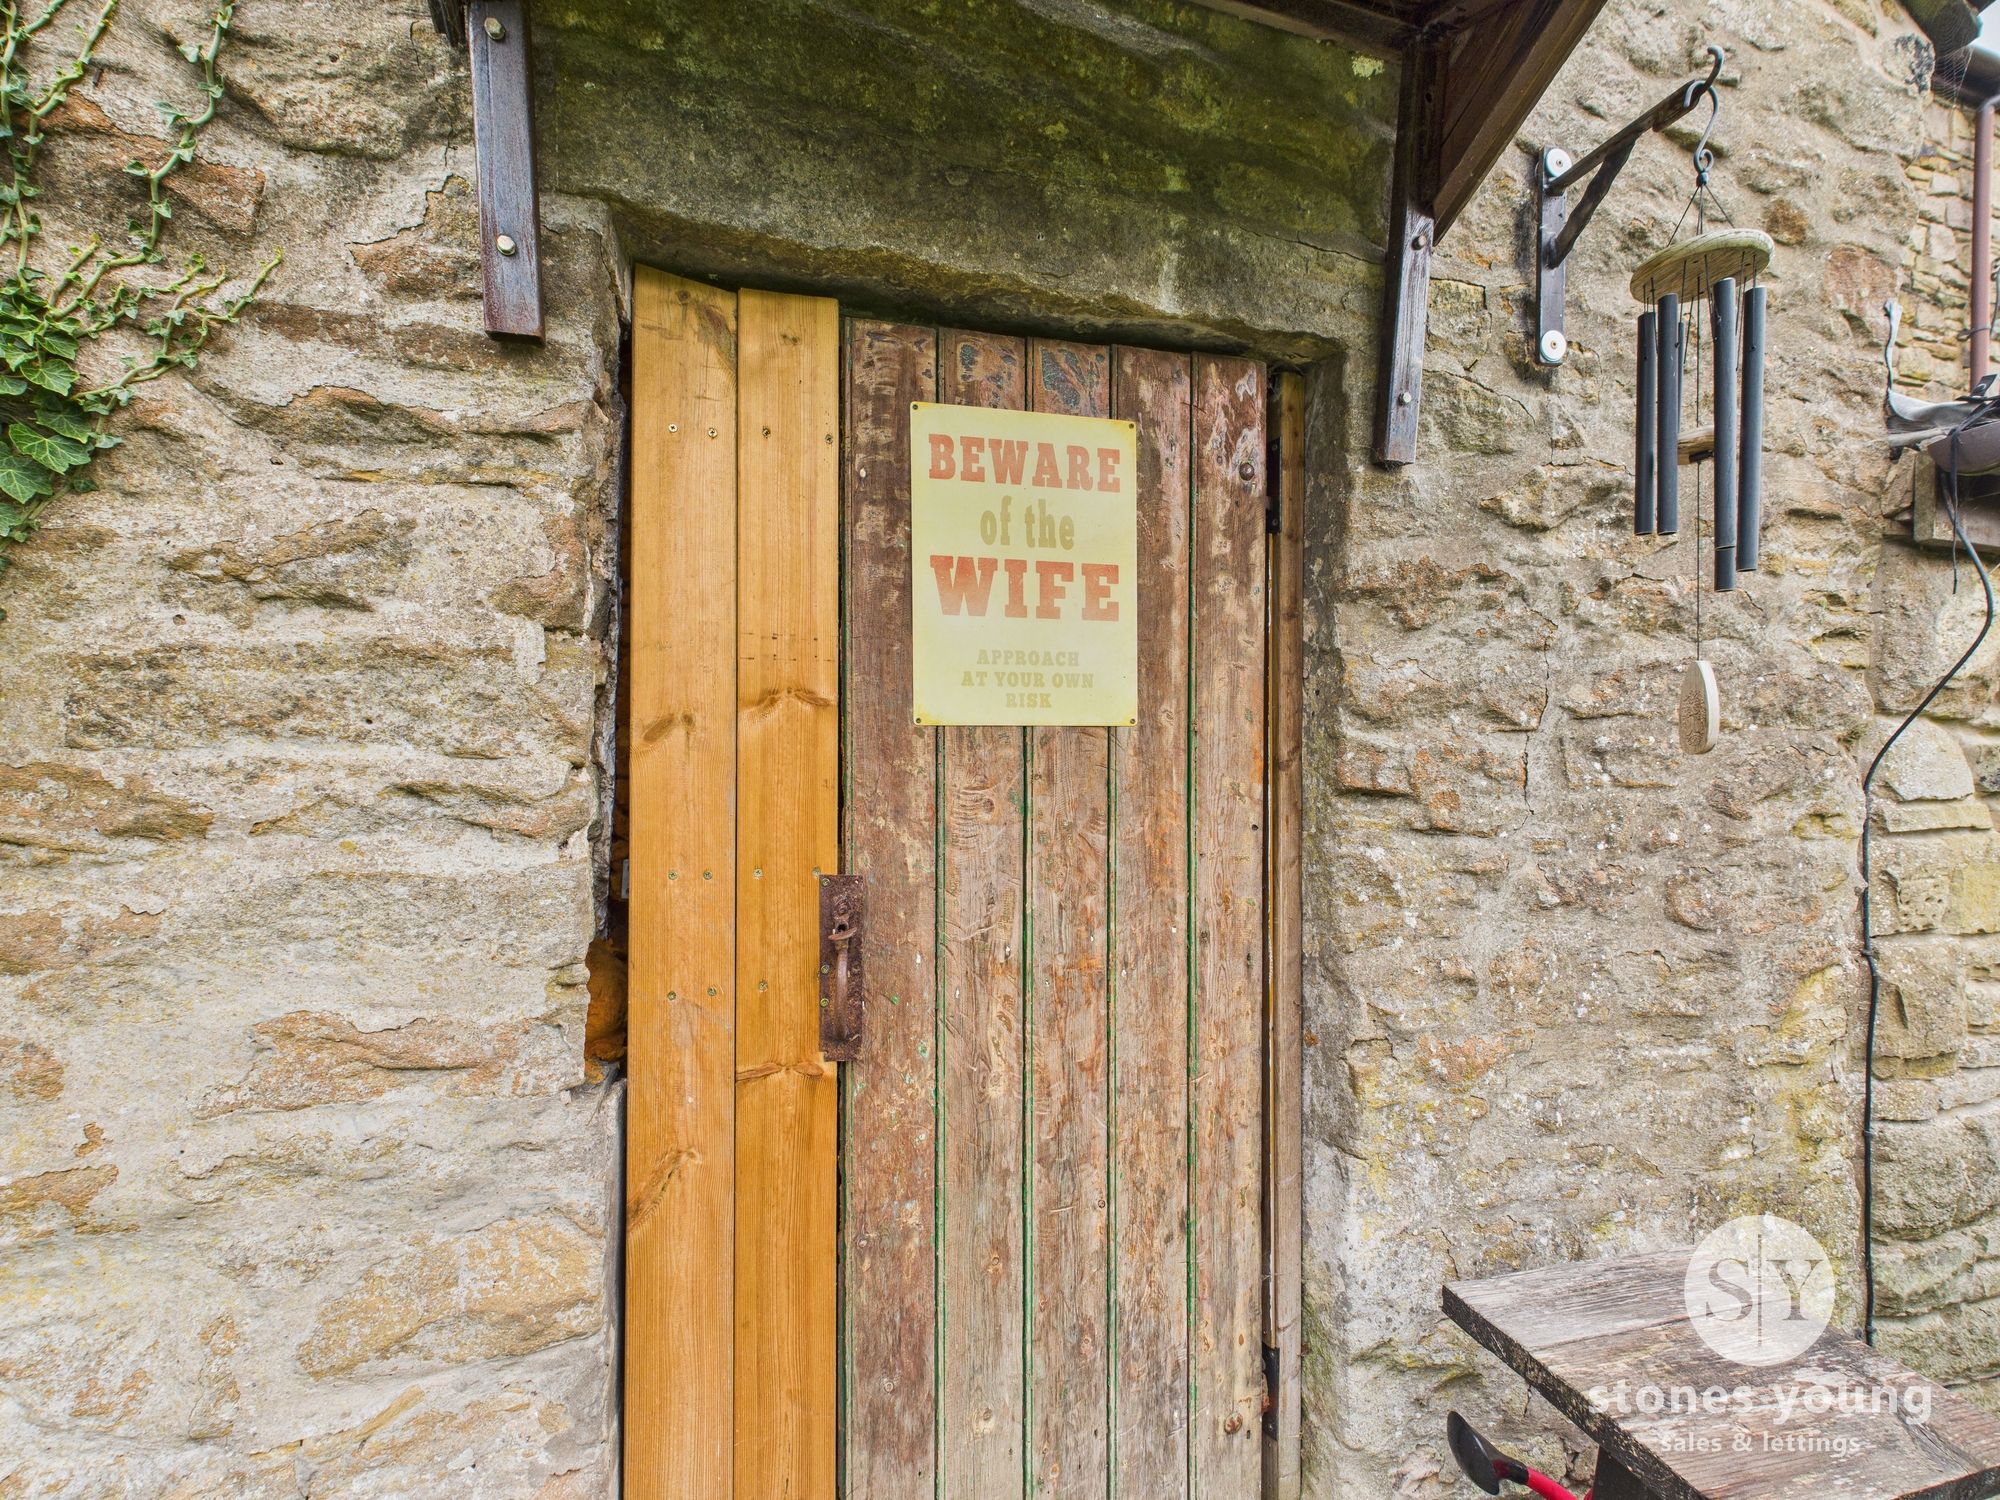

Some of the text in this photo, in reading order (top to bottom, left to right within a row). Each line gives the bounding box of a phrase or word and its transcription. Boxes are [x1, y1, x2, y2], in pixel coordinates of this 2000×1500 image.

[928, 433, 1121, 493] BEWARE
[980, 495, 1075, 550] of the
[929, 554, 1120, 622] WIFE
[976, 649, 1080, 667] APPROACH
[961, 671, 1094, 689] AT YOUR OWN
[1005, 692, 1052, 709] RISK
